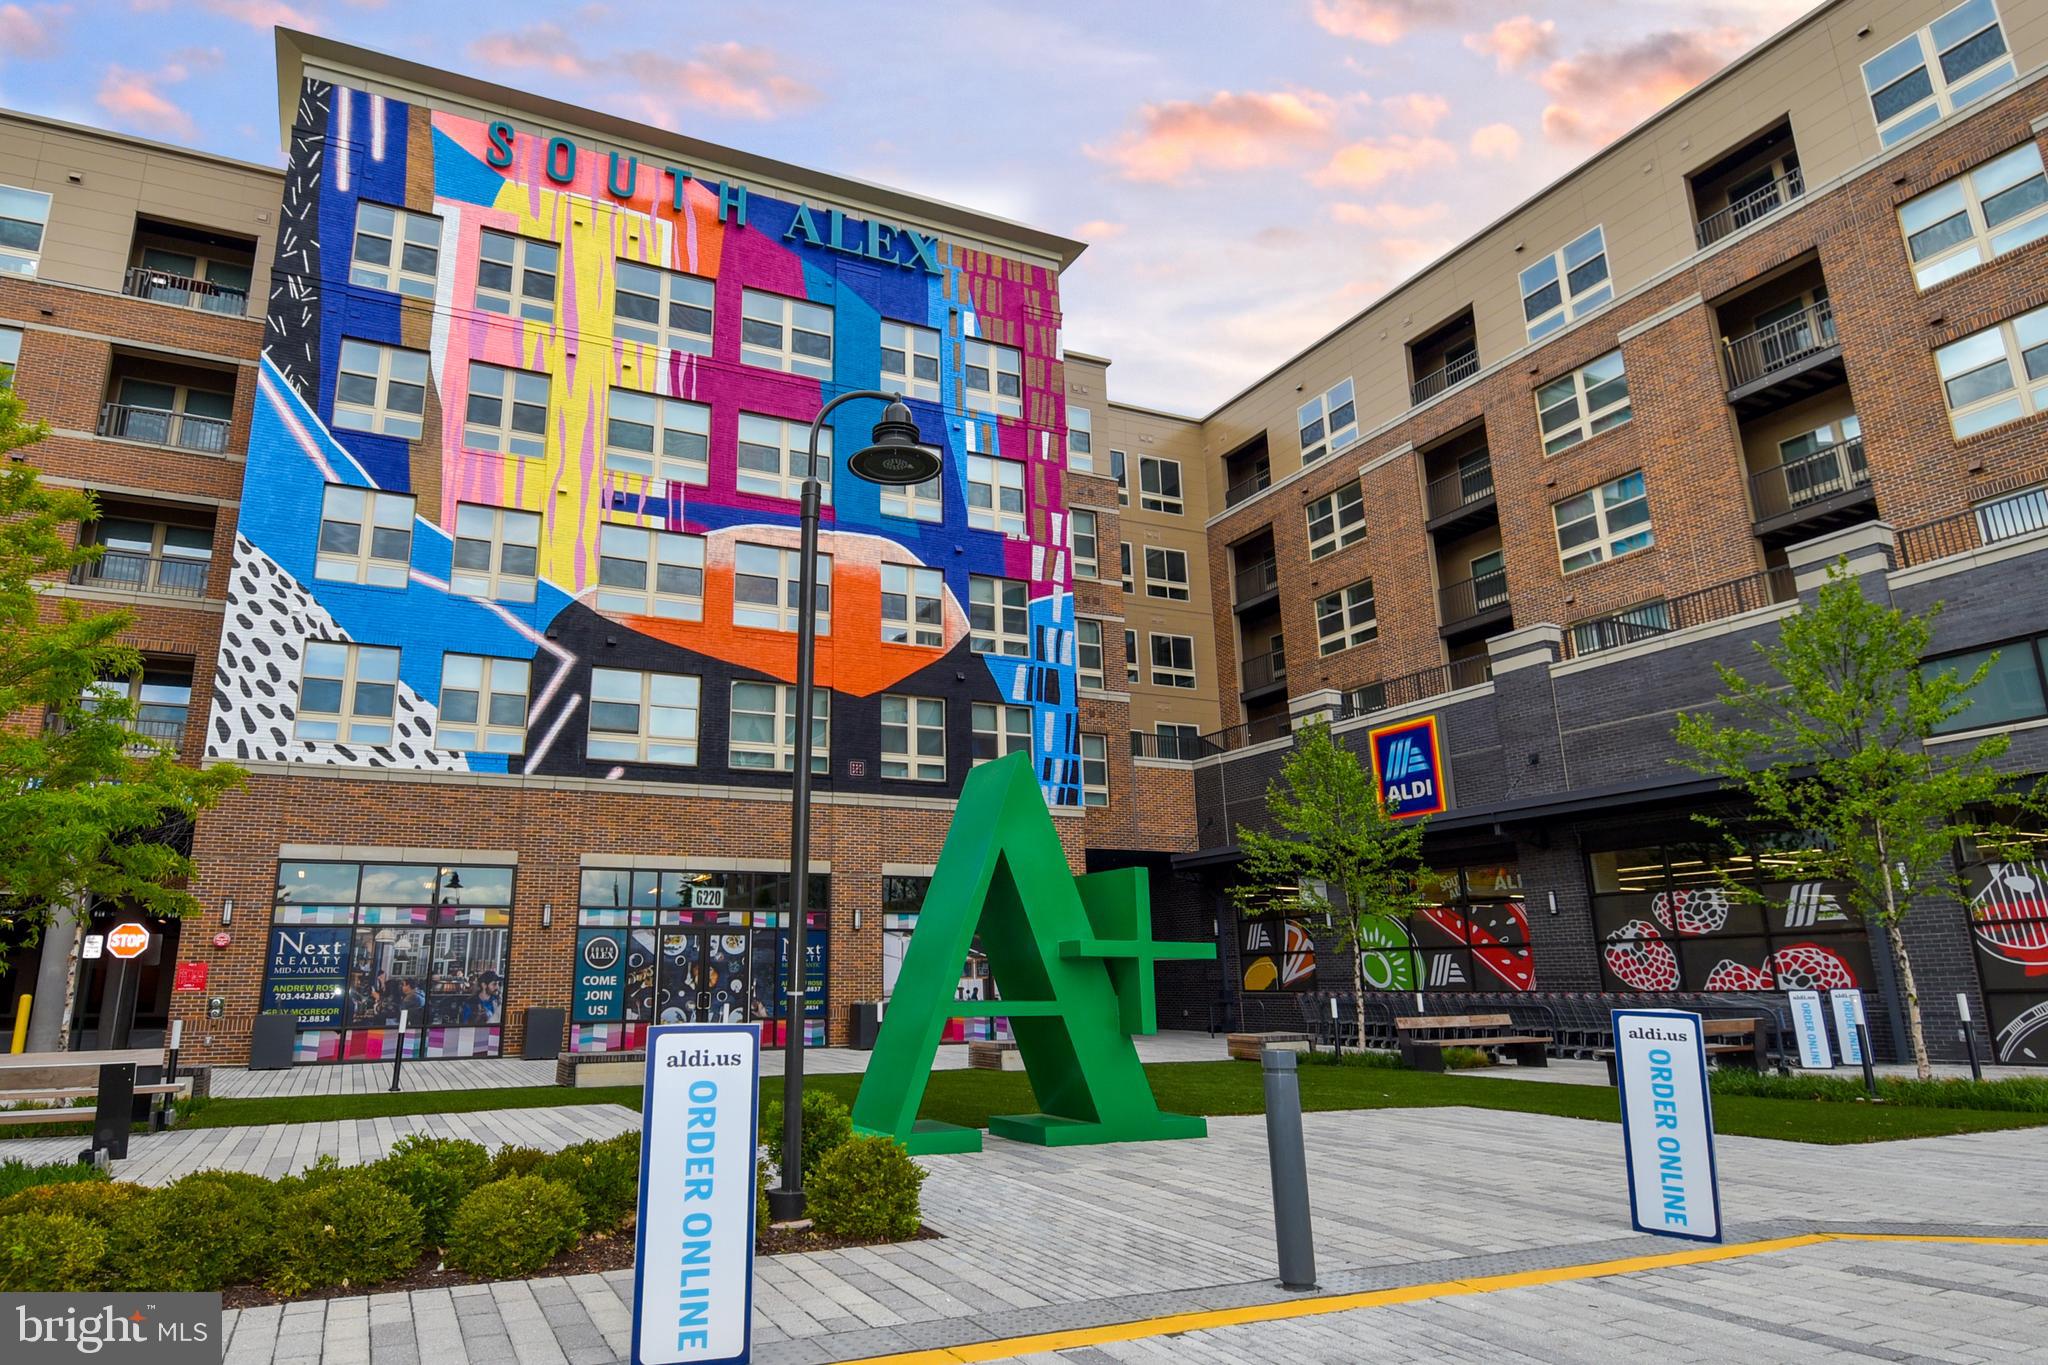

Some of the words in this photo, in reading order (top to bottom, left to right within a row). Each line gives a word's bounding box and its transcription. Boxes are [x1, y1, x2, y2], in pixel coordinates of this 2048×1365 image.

[486, 120, 747, 226] SOUTH
[783, 202, 943, 276] ALEX
[1387, 778, 1433, 802] ALDI
[696, 890, 722, 906] 6220
[111, 933, 145, 948] STOP
[275, 956, 341, 966] REALTY
[589, 951, 614, 959] ALEX
[273, 984, 314, 992] ANDREW
[582, 975, 617, 985] COME
[275, 992, 335, 1000] 703.442.8837
[584, 990, 613, 1000] JOIN
[588, 1005, 608, 1016] US!
[1801, 1002, 1815, 1032] ORDER
[1842, 1000, 1855, 1030] ORDER
[1628, 1027, 1688, 1042] aldi.us
[1807, 1033, 1821, 1065] ONLINE
[1848, 1031, 1861, 1062] ONLINE
[666, 1049, 742, 1068] aldi.us
[1648, 1048, 1678, 1129] ORDER
[684, 1080, 718, 1202] ORDER
[1657, 1136, 1688, 1227] ONLINE
[677, 1212, 712, 1352] ONLINE
